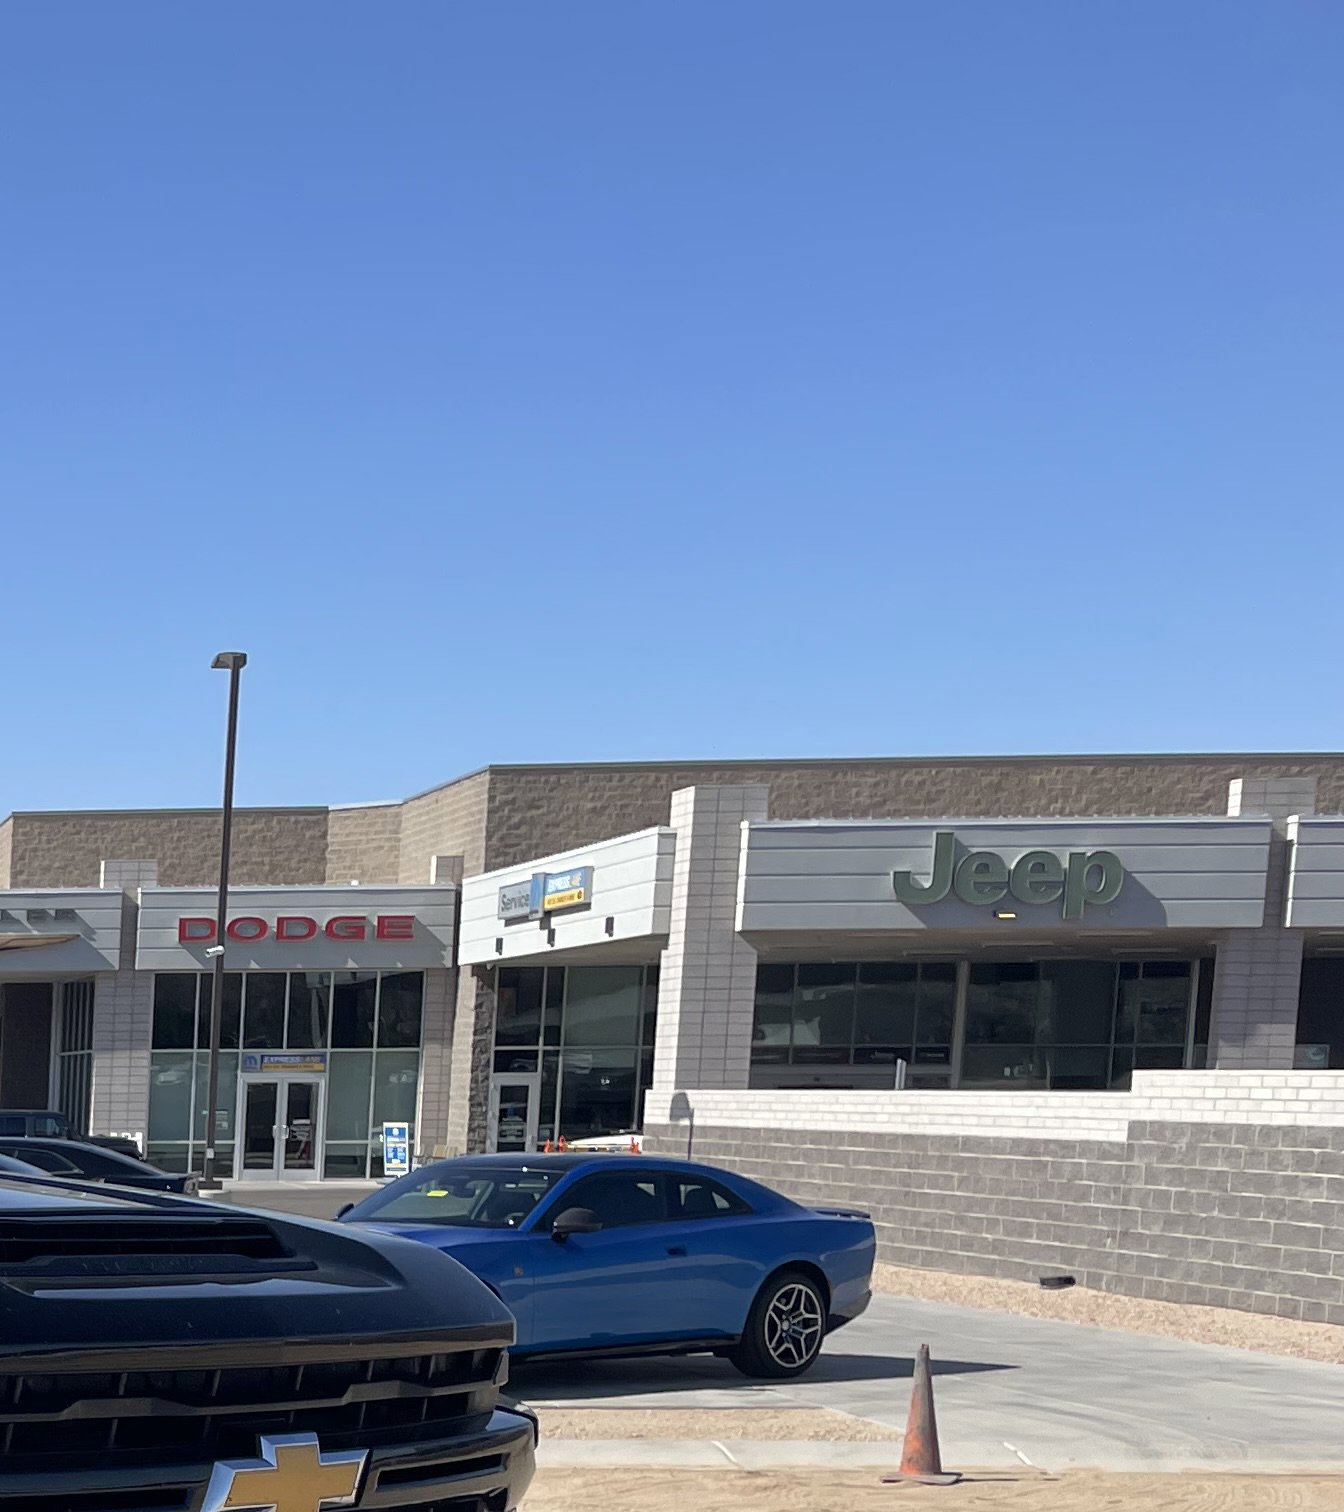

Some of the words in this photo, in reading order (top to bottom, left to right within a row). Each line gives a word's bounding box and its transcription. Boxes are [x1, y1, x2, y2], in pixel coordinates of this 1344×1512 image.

[892, 831, 1124, 920] Jeep
[501, 890, 530, 912] Service
[178, 915, 415, 943] DODGE
